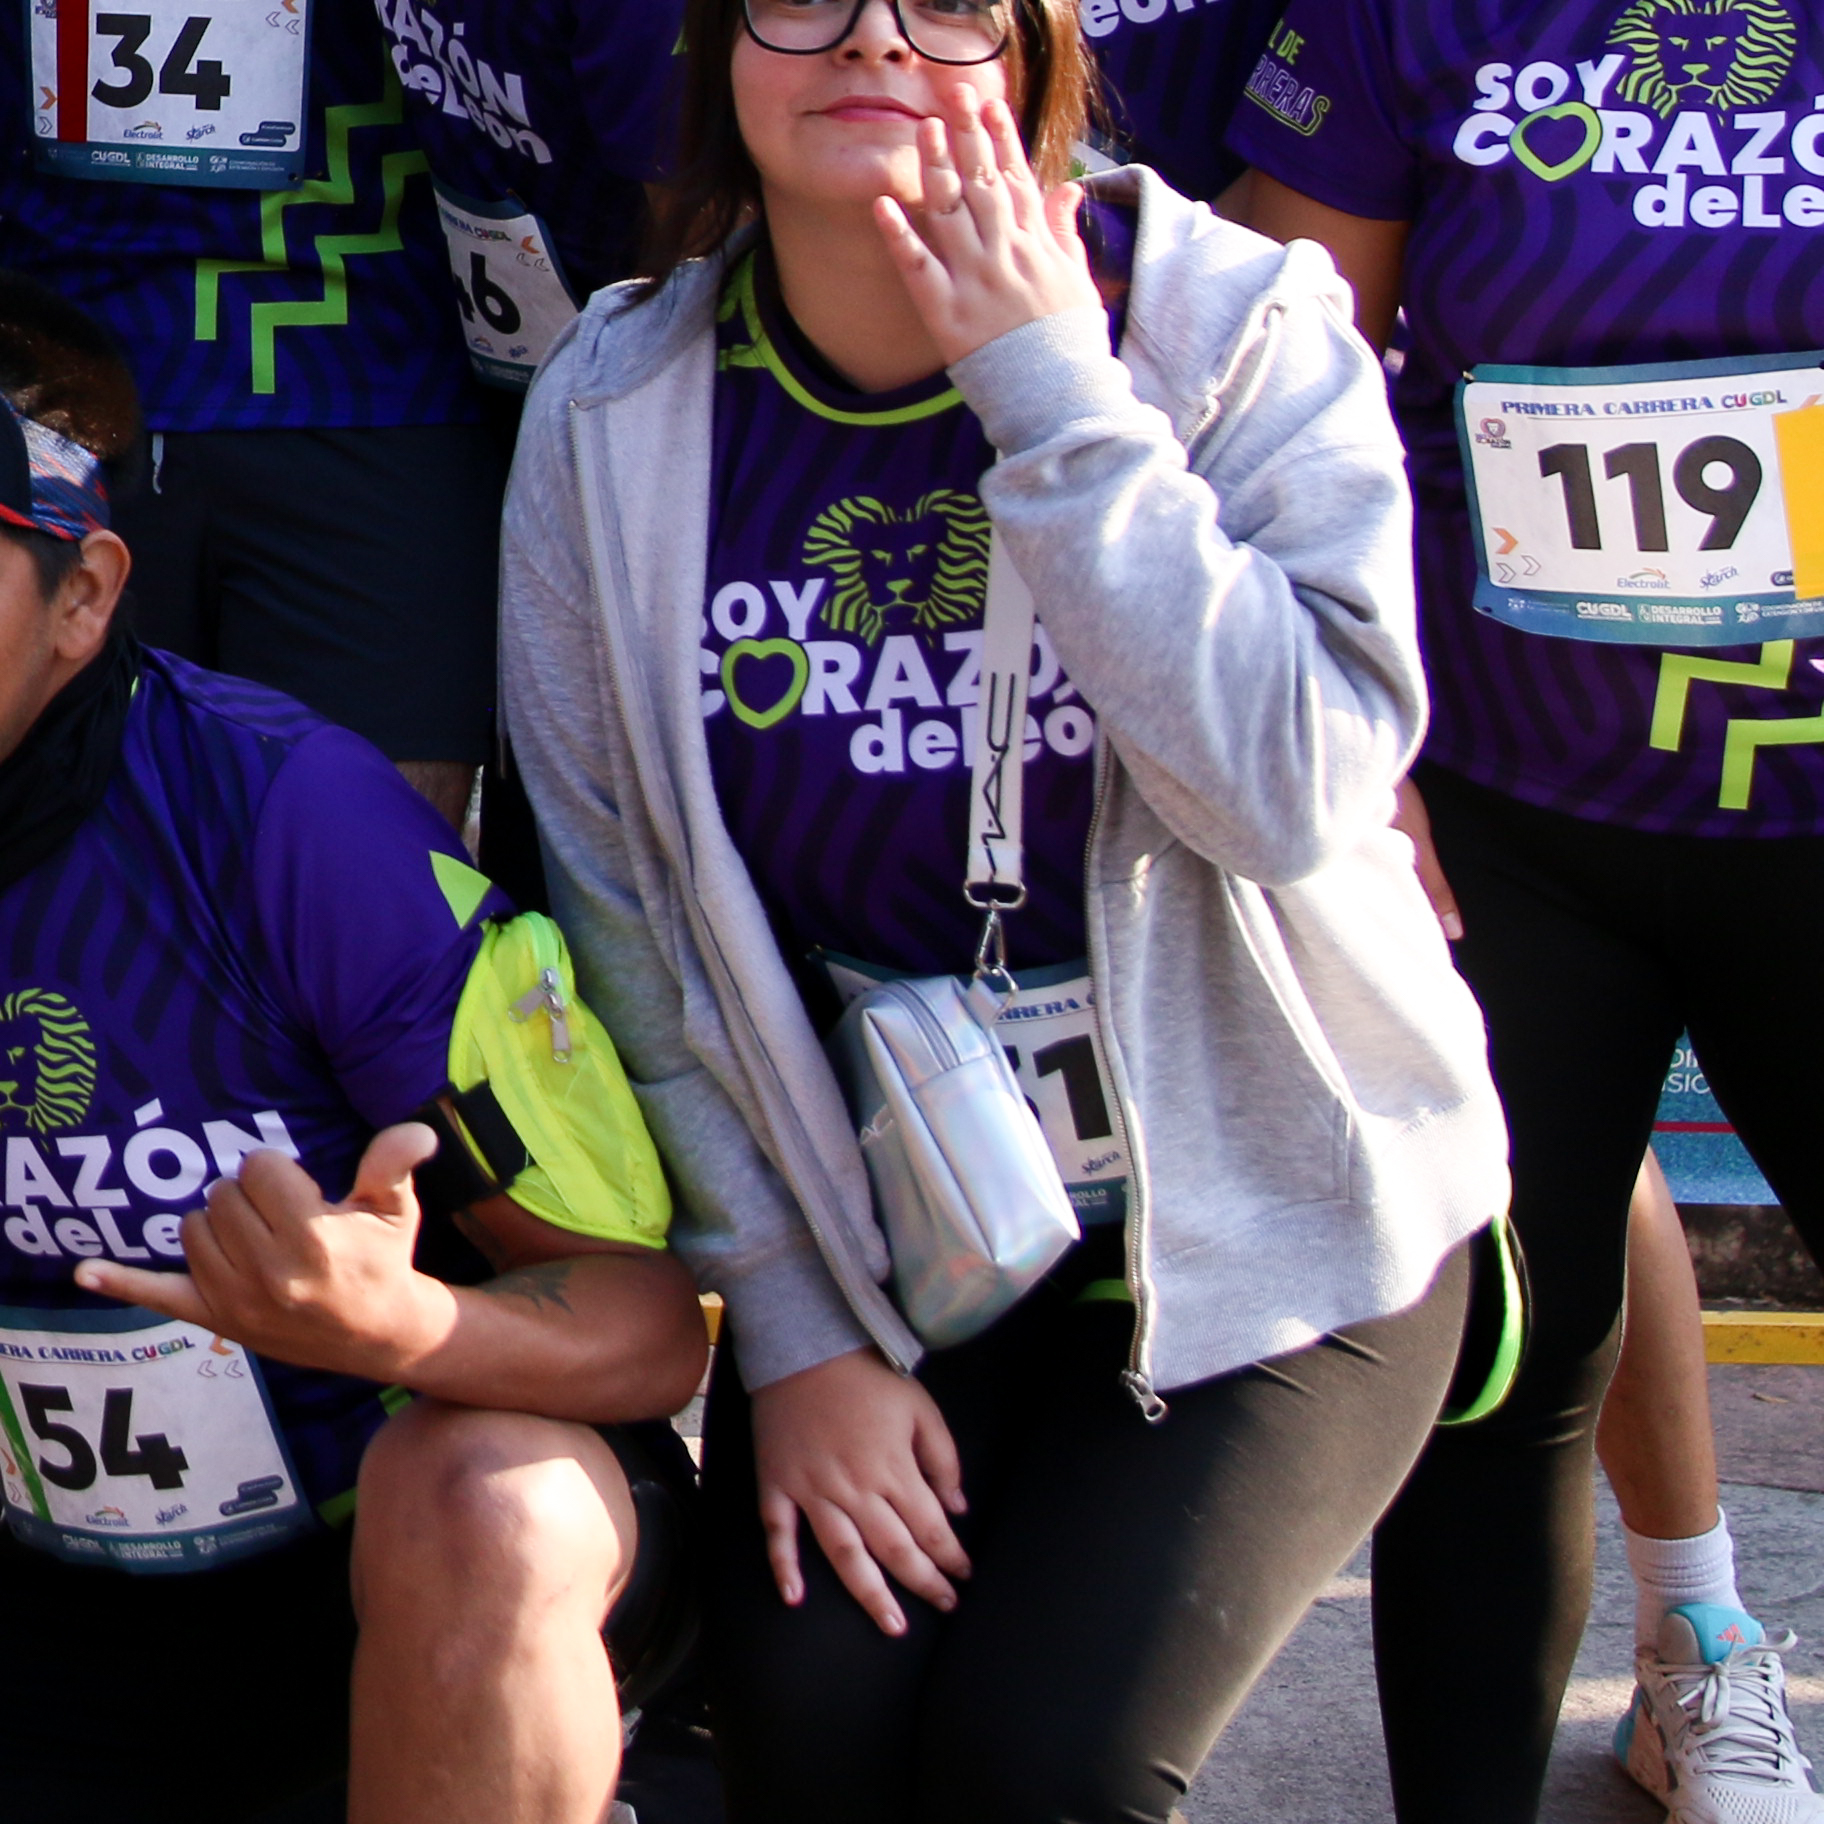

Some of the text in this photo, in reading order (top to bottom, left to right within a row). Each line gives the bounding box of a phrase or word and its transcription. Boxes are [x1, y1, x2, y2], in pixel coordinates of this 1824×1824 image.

[91, 12, 232, 111] 34
[1472, 53, 1628, 113] SOY
[1501, 389, 1788, 416] PRIMERA CARRERA CUGDL
[1538, 435, 1763, 553] 119
[702, 578, 825, 642] OY
[5, 1205, 182, 1261] deLe
[131, 1336, 196, 1363] CUGDL
[19, 1382, 190, 1492] 54
